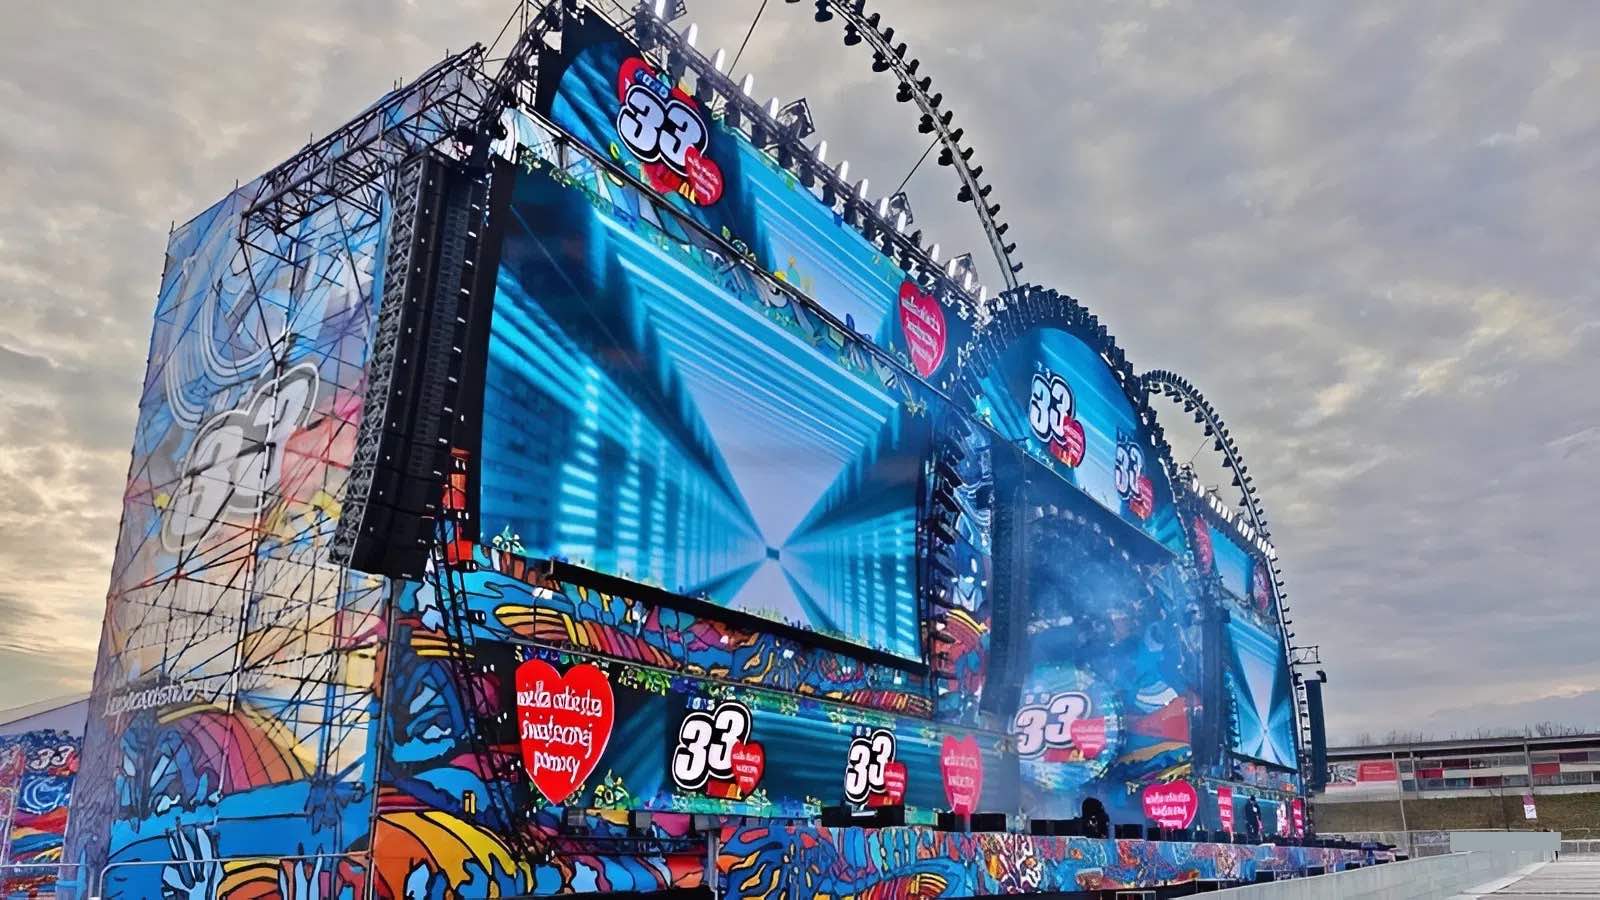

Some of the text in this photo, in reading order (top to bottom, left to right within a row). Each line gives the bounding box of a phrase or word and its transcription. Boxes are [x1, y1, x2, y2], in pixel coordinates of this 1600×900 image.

[618, 87, 706, 173] 33
[1030, 377, 1073, 440] 33
[165, 370, 315, 545] 33
[1115, 444, 1144, 497] 33
[31, 745, 74, 770] 33
[673, 706, 748, 785] 33
[1015, 694, 1088, 757] 33
[846, 733, 894, 798] 33
